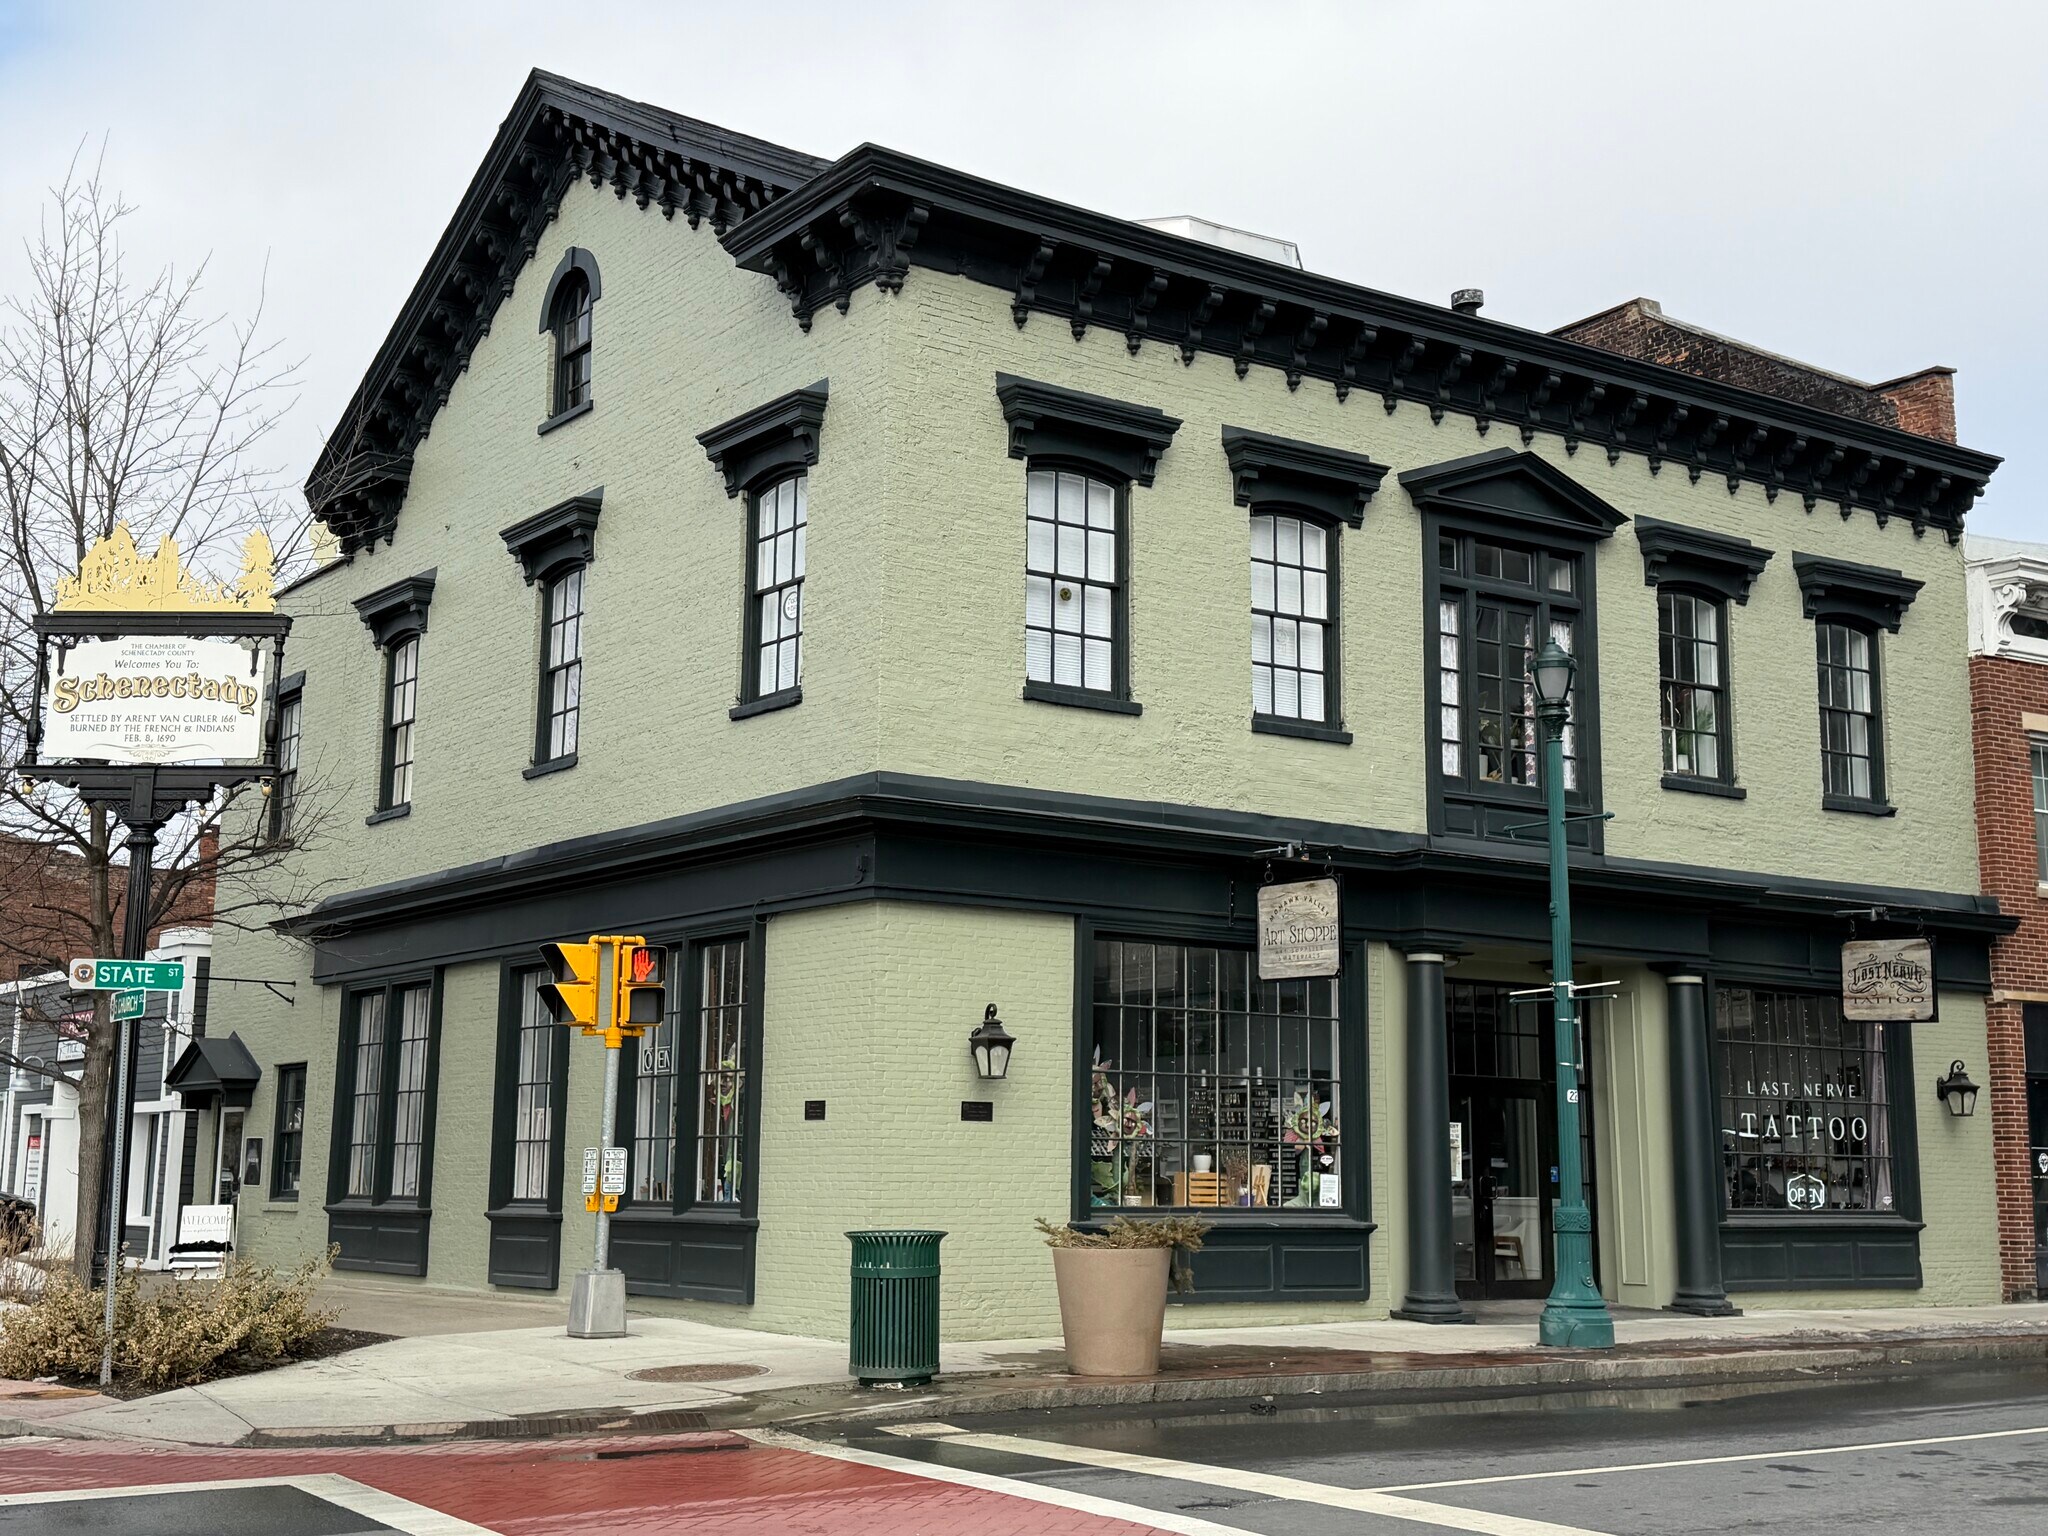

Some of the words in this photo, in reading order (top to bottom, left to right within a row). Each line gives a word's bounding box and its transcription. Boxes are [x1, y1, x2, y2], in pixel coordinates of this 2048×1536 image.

[114, 659, 160, 669] Welcomes
[165, 659, 182, 669] You
[186, 659, 199, 669] To:
[53, 671, 258, 716] Schenectady
[70, 714, 108, 722] SETTLED
[111, 714, 122, 722] BY
[125, 714, 156, 722] ARENT
[159, 714, 180, 722] VAN
[183, 714, 218, 722] CURLER
[221, 714, 237, 723] 1661
[70, 724, 107, 732] BURNED
[110, 724, 121, 732] BY
[124, 724, 141, 732] THE
[144, 724, 181, 732] FRENCH
[184, 724, 192, 732] &
[196, 724, 235, 732] INDIANS
[124, 734, 142, 742] FEB.
[145, 734, 153, 743] 8,
[157, 734, 176, 742] 1690
[1269, 895, 1300, 922] MOHAWK
[1303, 895, 1330, 917] VALLEY
[1263, 927, 1285, 946] ART
[1289, 924, 1337, 944] SHOPPE
[98, 966, 156, 984] STATE
[168, 968, 180, 977] ST
[1851, 996, 1925, 1005] TATTOO
[644, 1050, 670, 1070] OEN
[1747, 1080, 1790, 1096] LAST
[1803, 1082, 1856, 1098] NERVE
[1740, 1112, 1868, 1141] TATTOO
